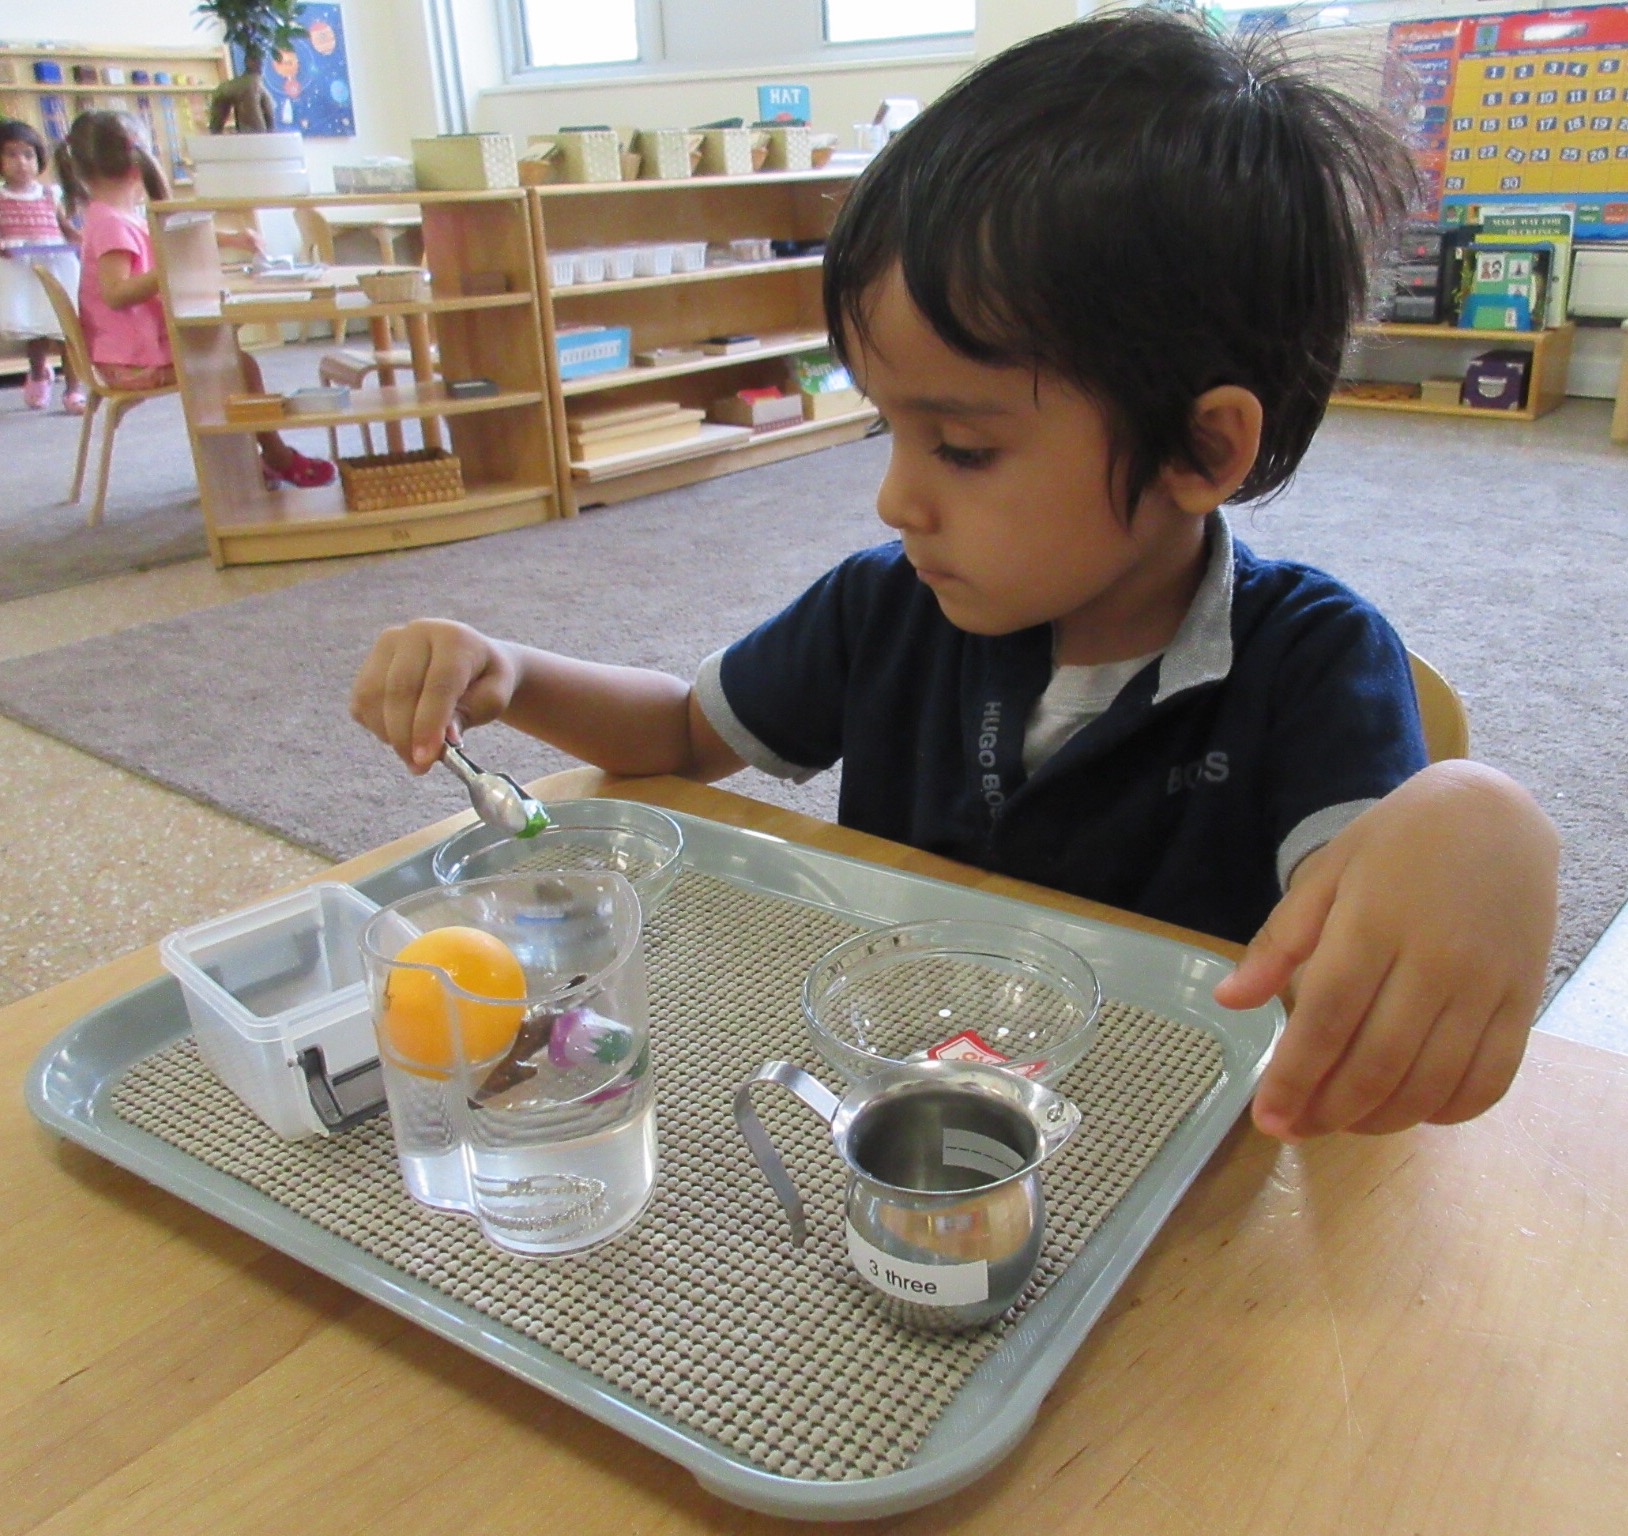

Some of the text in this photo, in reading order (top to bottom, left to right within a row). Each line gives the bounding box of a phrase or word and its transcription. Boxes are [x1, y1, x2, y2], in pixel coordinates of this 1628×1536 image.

[769, 88, 801, 104] HAT
[1456, 118, 1468, 130] 14
[1482, 119, 1496, 131] 15
[1511, 116, 1524, 128] 16
[1539, 118, 1553, 130] 17
[1593, 118, 1608, 129] 19
[1618, 118, 1628, 129] 2
[1452, 149, 1466, 160] 21
[1479, 146, 1495, 159] 22
[1531, 149, 1547, 161] 24
[1588, 149, 1606, 162] 26
[1617, 146, 1628, 157] 2
[1503, 176, 1519, 189] 30
[978, 701, 1002, 768] HUGO
[869, 1259, 937, 1295] 3 three
